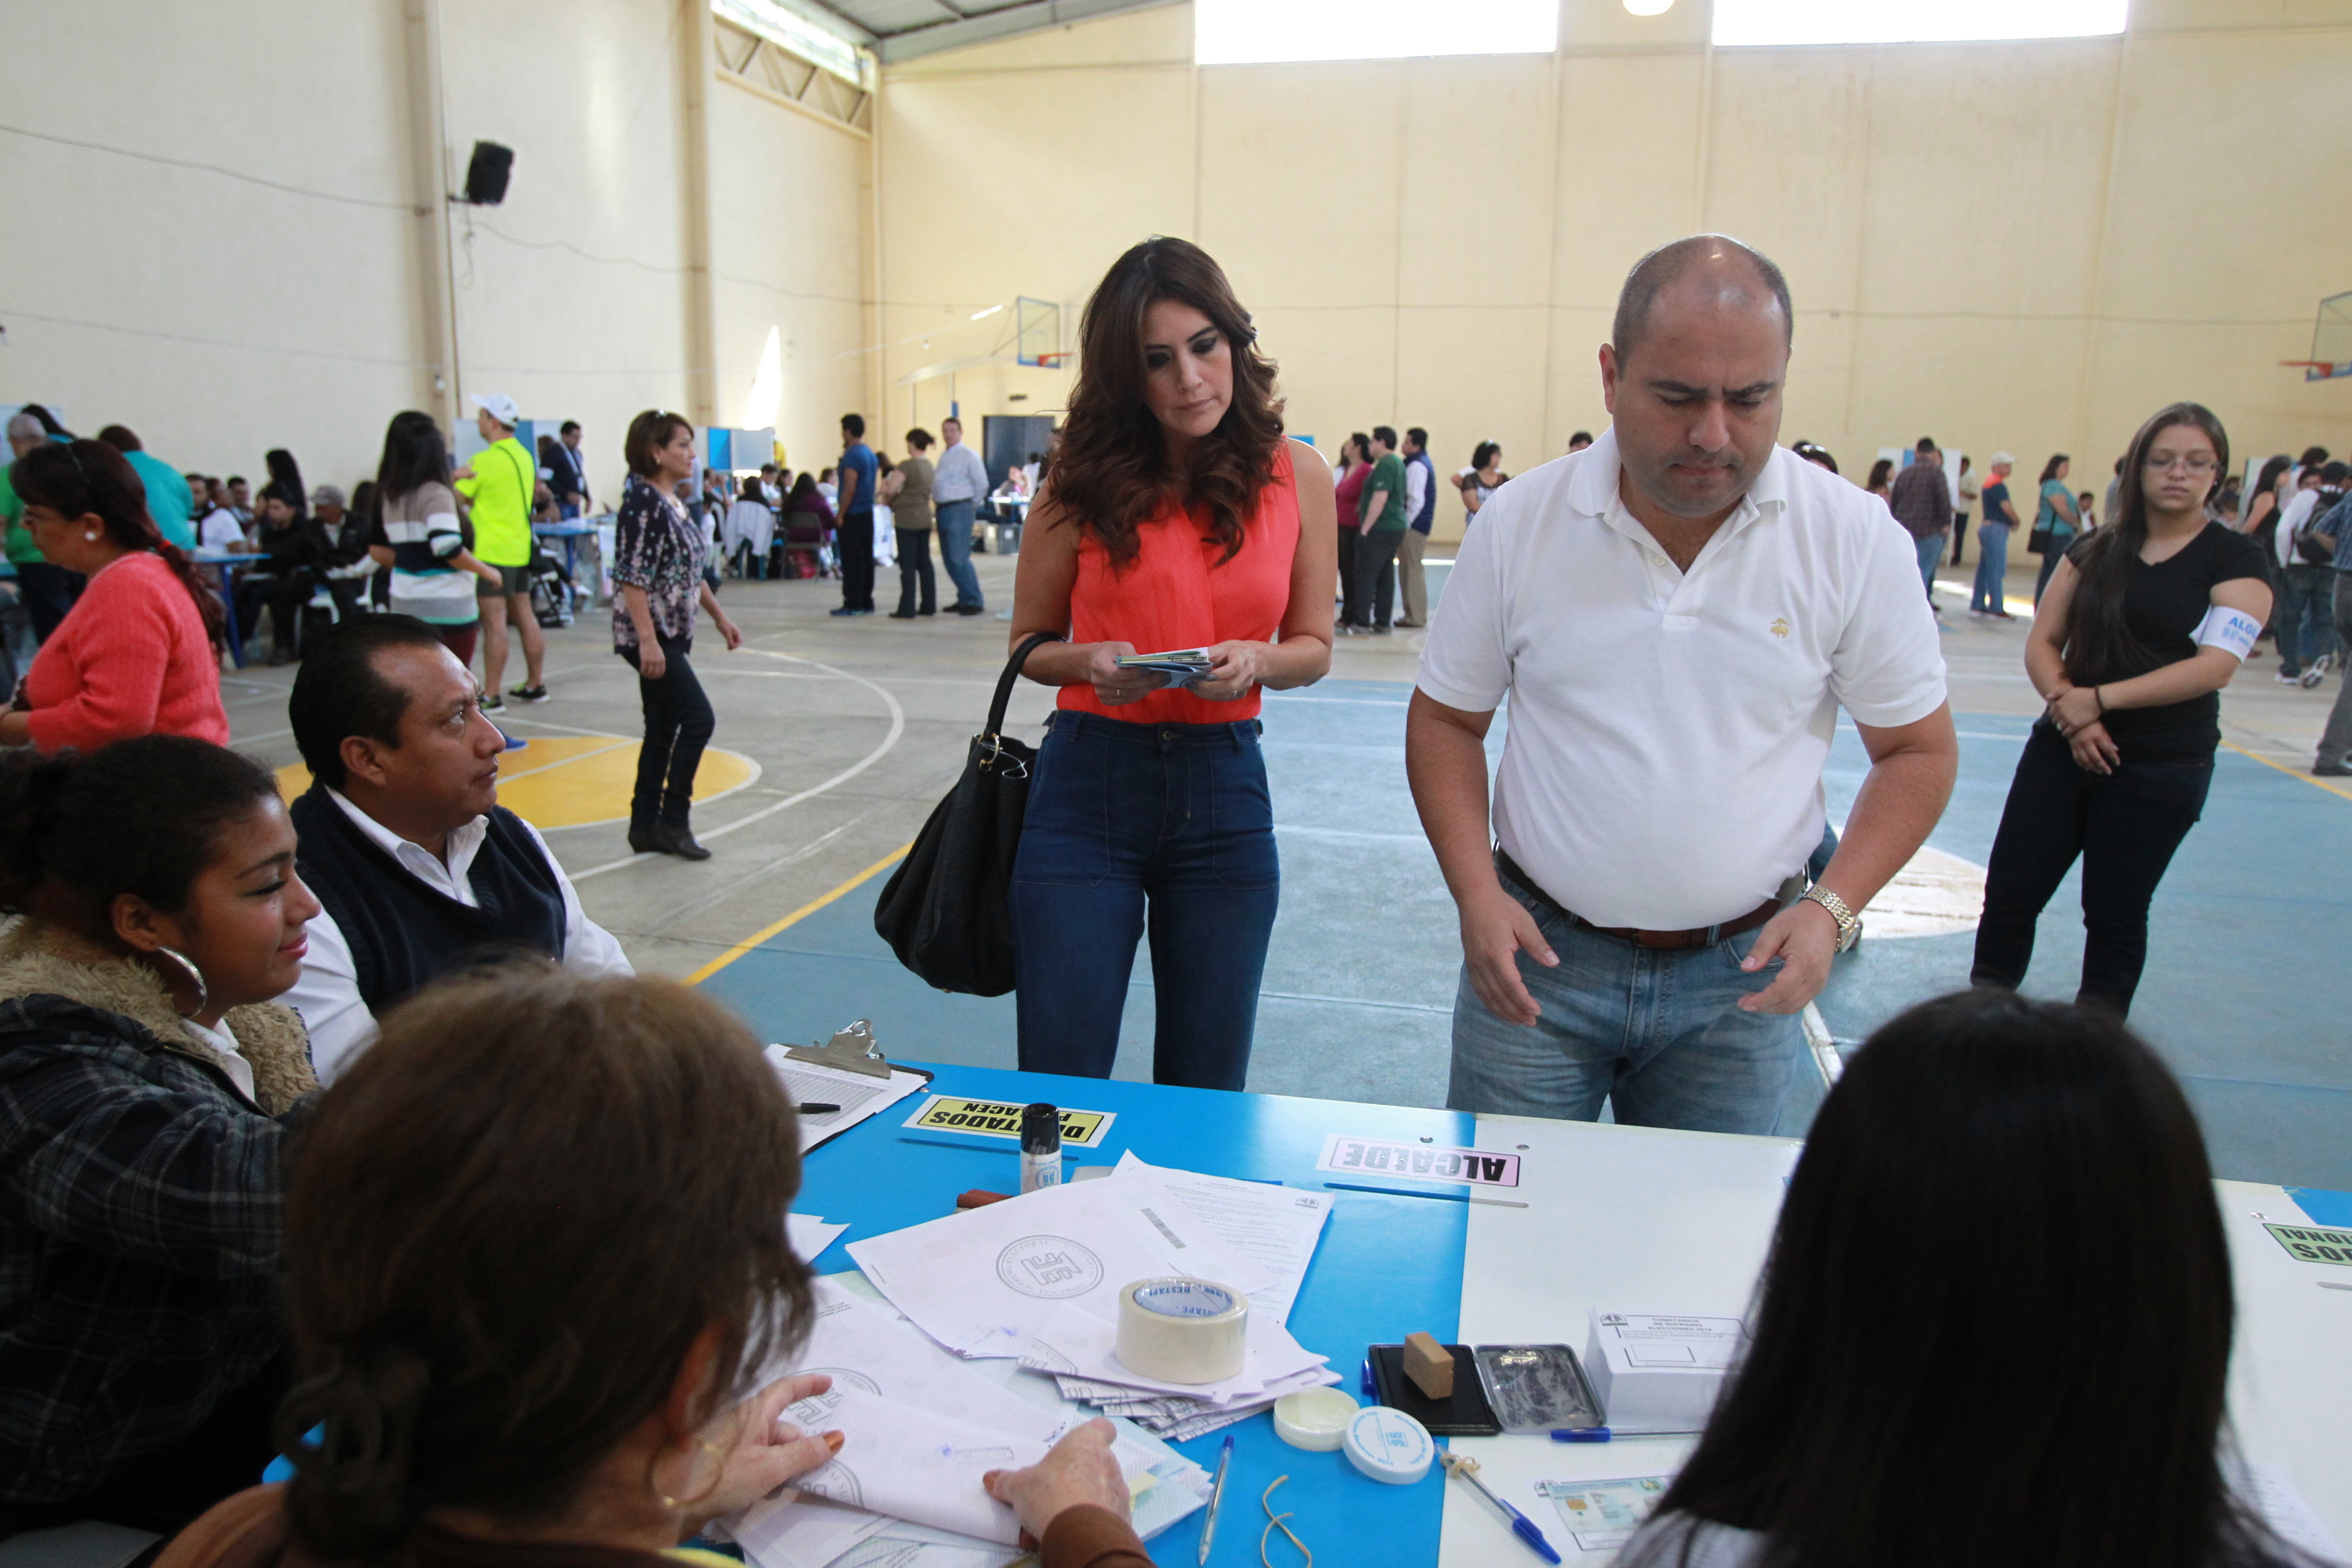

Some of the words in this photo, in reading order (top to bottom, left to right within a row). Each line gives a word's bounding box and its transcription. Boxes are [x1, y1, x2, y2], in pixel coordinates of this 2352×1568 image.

[962, 1102, 1073, 1122] PACEN
[930, 1111, 1087, 1139] DTADOS
[1342, 1143, 1507, 1182] ALCALDE
[2275, 1228, 2352, 1246] IONAL
